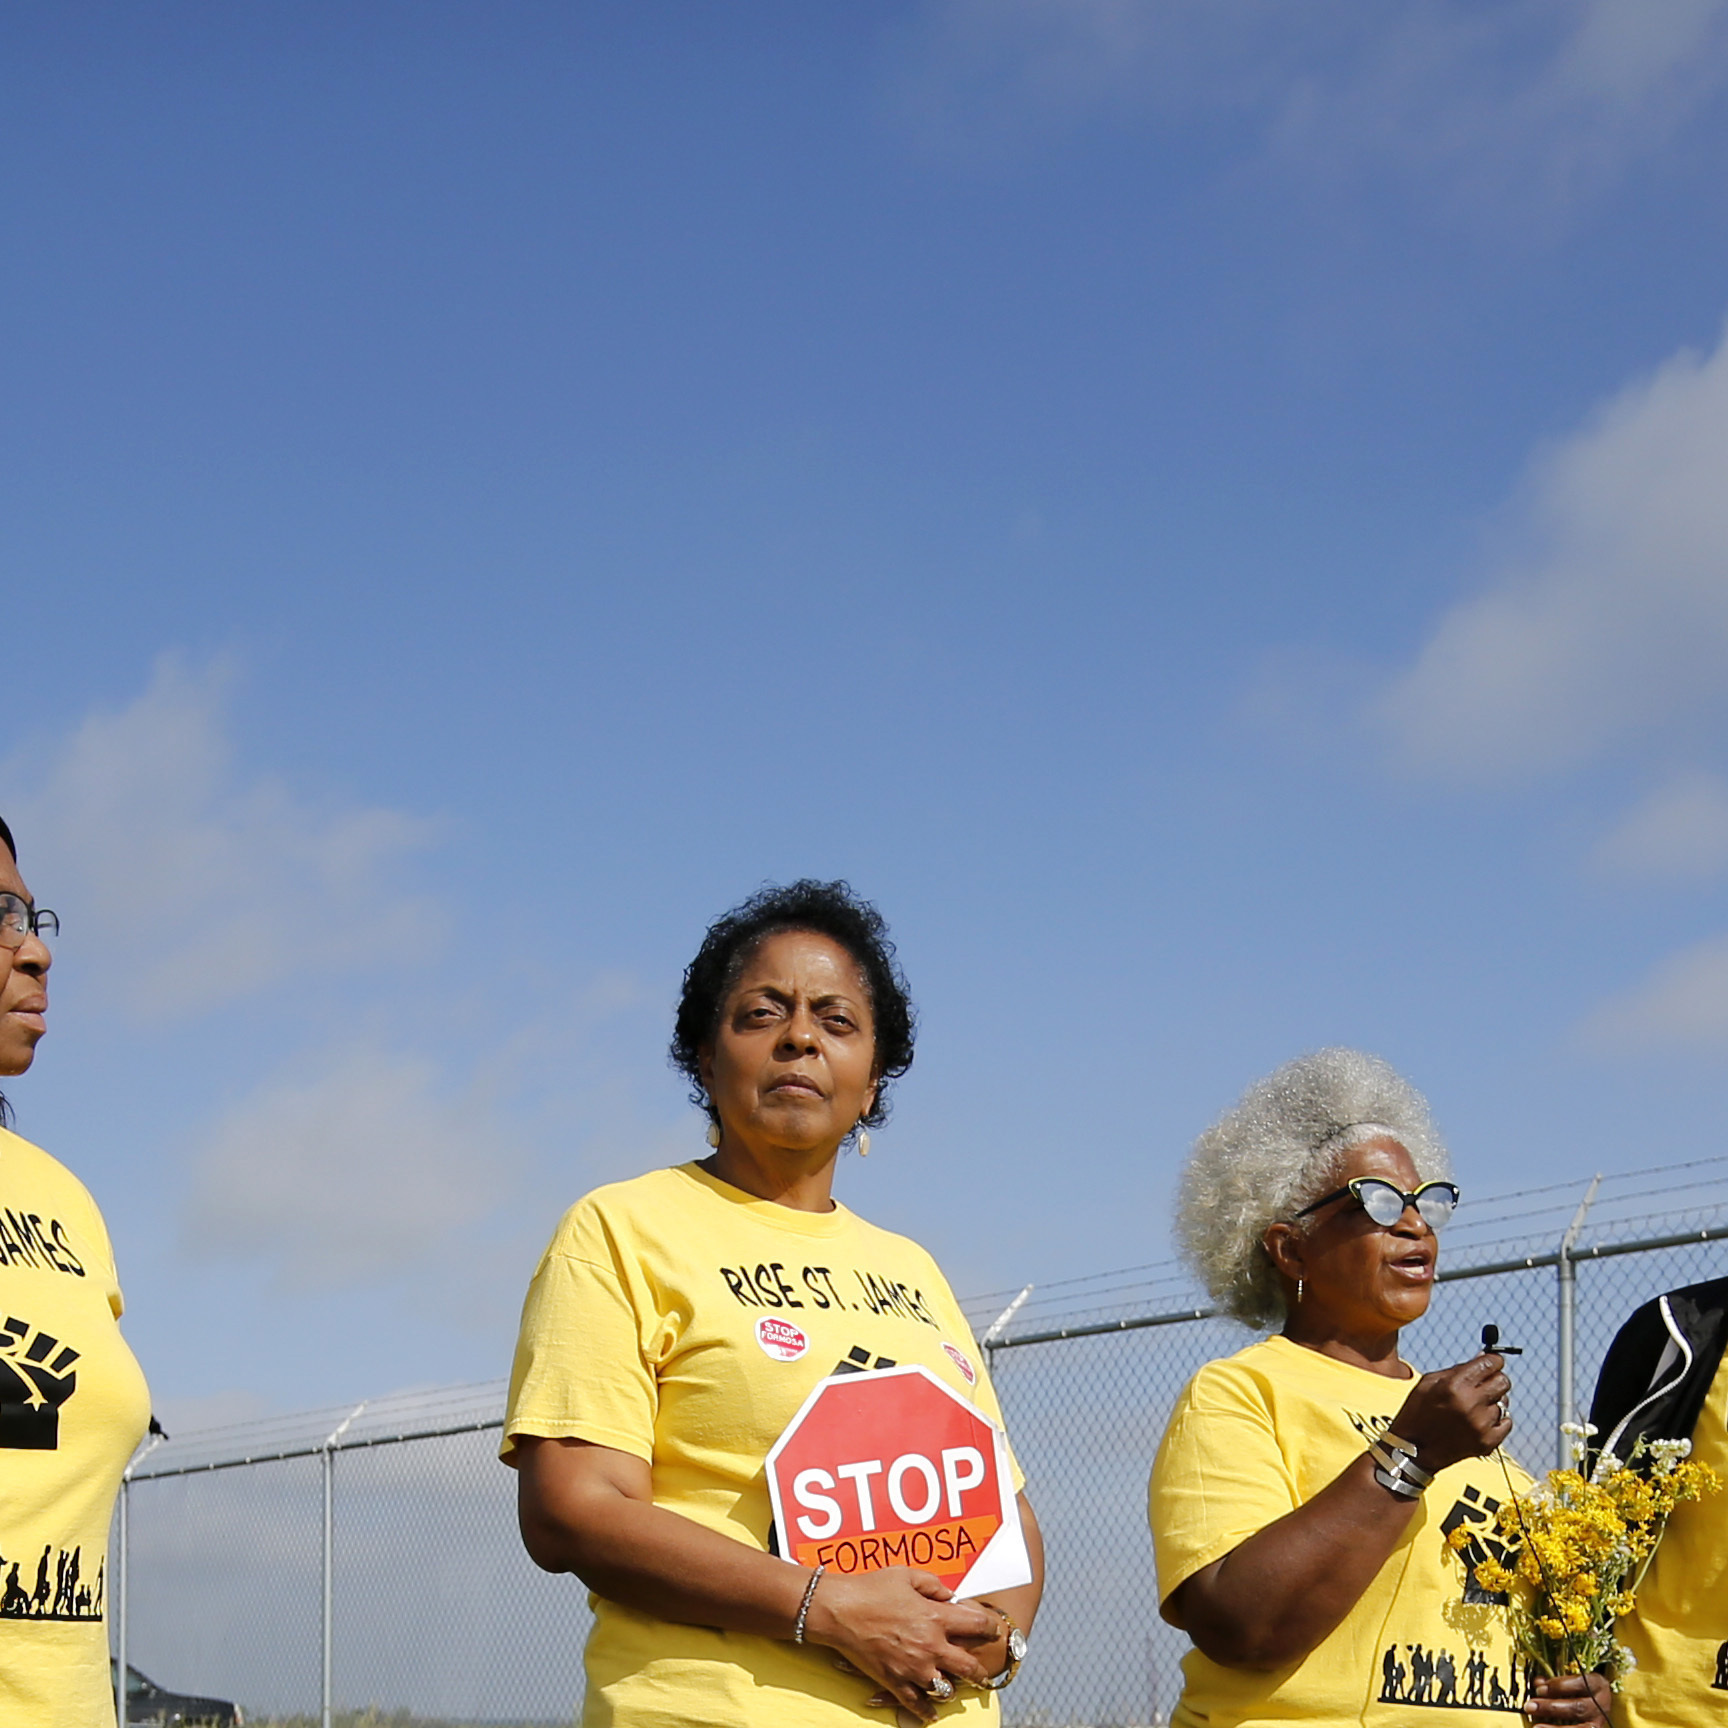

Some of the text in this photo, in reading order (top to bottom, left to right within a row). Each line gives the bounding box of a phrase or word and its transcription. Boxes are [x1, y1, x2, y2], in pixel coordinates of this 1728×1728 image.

[719, 1262, 941, 1333] RISE ST. JAMES
[761, 1330, 804, 1347] FORMOSA
[764, 1321, 799, 1338] STOP
[792, 1445, 986, 1541] STOP
[816, 1524, 977, 1575] FORMOSA
